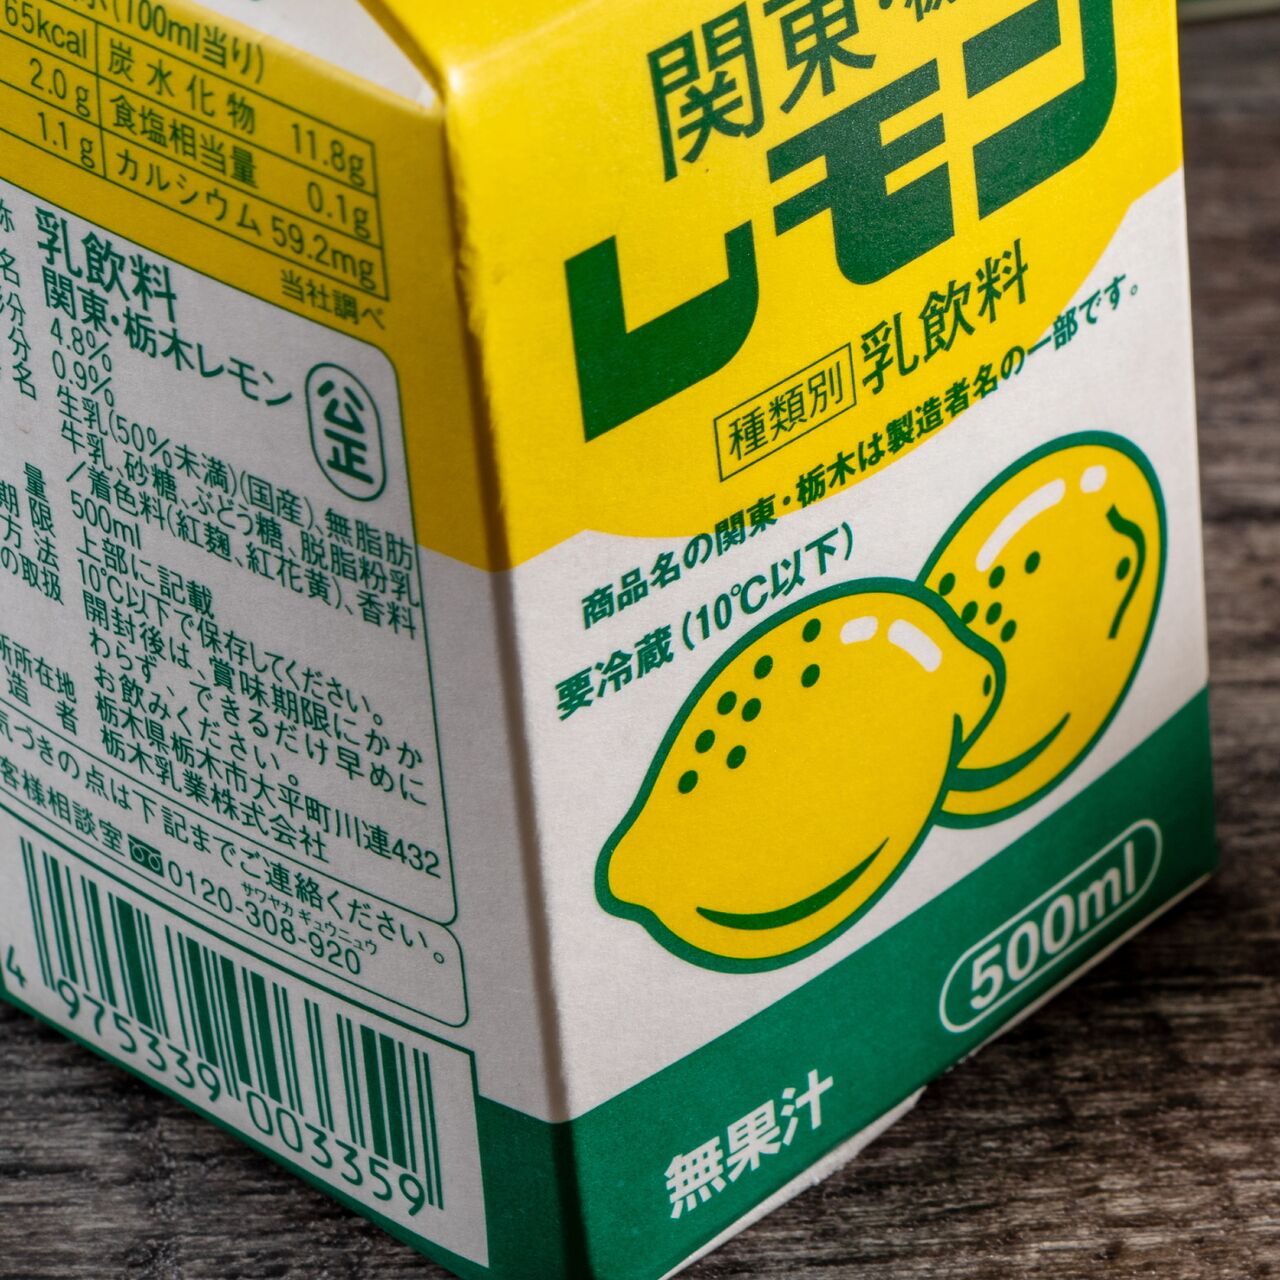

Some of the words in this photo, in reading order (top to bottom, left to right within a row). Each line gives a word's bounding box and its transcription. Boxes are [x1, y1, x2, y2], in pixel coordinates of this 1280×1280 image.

[109, 94, 259, 189] 食塩相当量
[308, 181, 371, 241] 0.1g
[292, 122, 366, 189] 11.8g
[35, 206, 177, 323] 乳飲料
[116, 149, 262, 236] カルシウム
[271, 216, 377, 293] 59.2mg
[42, 265, 292, 406] 関東・栃木レモン
[51, 318, 112, 372] 4.8%
[281, 269, 386, 331] 当社調べ
[727, 372, 844, 461] 種類別
[859, 237, 1029, 397] 乳飲料
[52, 350, 114, 408] 0.9%
[71, 490, 142, 551] 500ml
[76, 526, 215, 620] 上部に記載
[101, 725, 330, 864] 栃木乳業株式会社
[169, 861, 361, 975] 0120-308-920
[969, 841, 1137, 1012] 500ml
[664, 1069, 834, 1220] 無果汁
